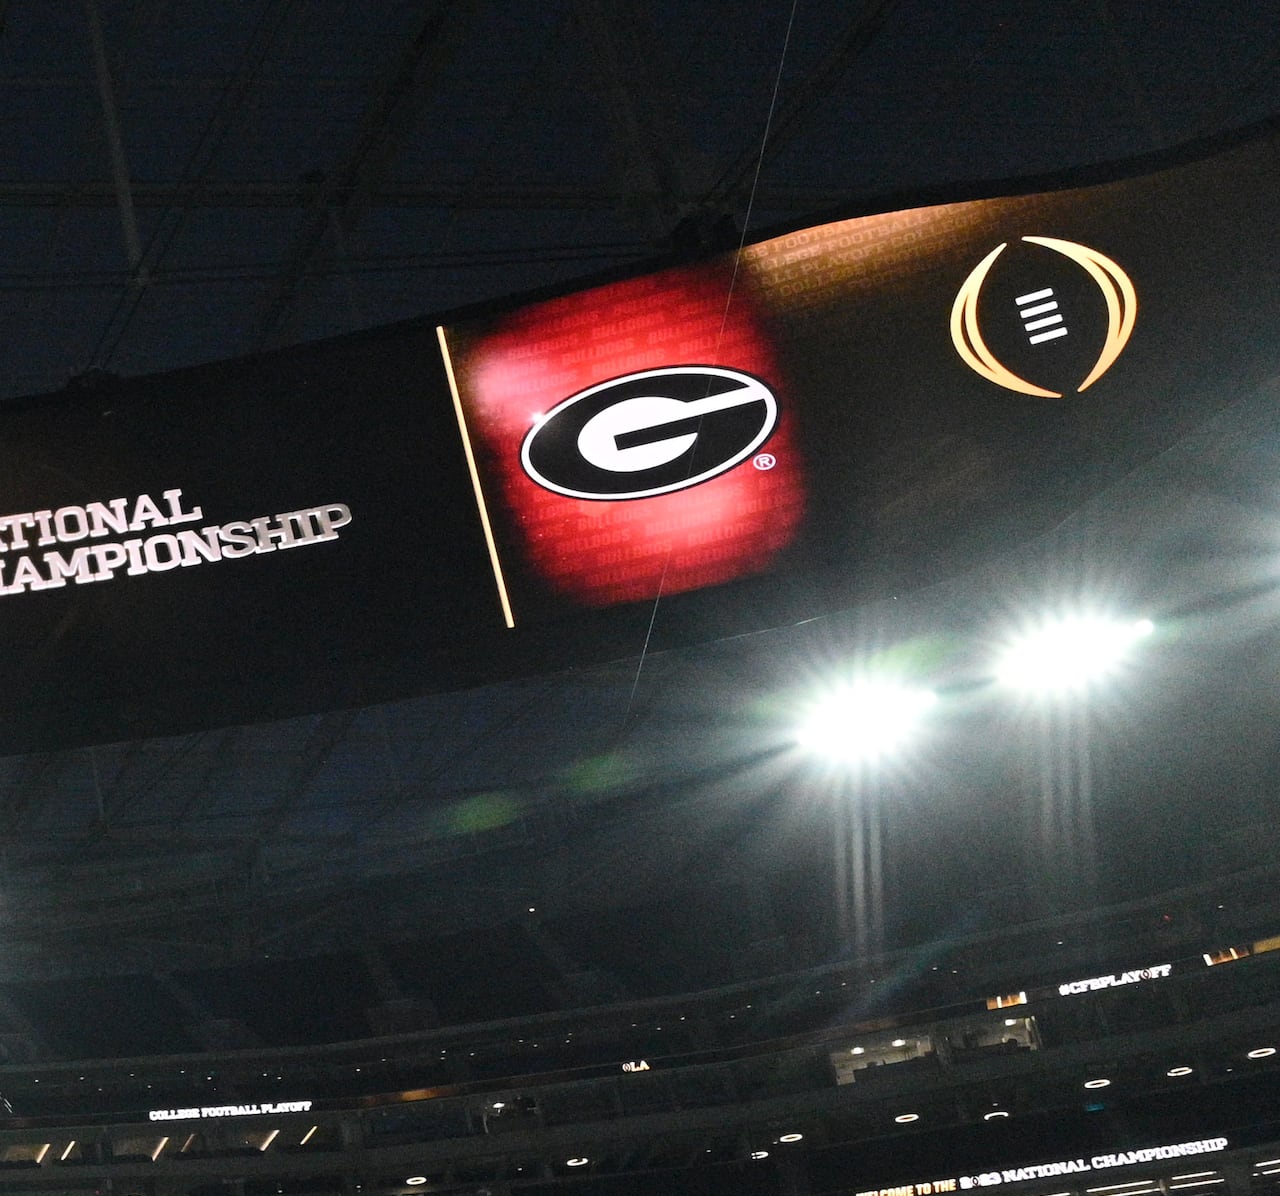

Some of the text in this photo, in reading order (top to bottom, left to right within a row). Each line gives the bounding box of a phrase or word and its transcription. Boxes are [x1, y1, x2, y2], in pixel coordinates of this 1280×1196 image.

[149, 1101, 311, 1120] COLLEGE FOOTBALL PLAYOFF
[915, 1183, 932, 1195] TO
[932, 1179, 956, 1193] THE
[1001, 1159, 1091, 1183] NATIONAL
[1091, 1137, 1228, 1169] CHAMPIONSHIP
